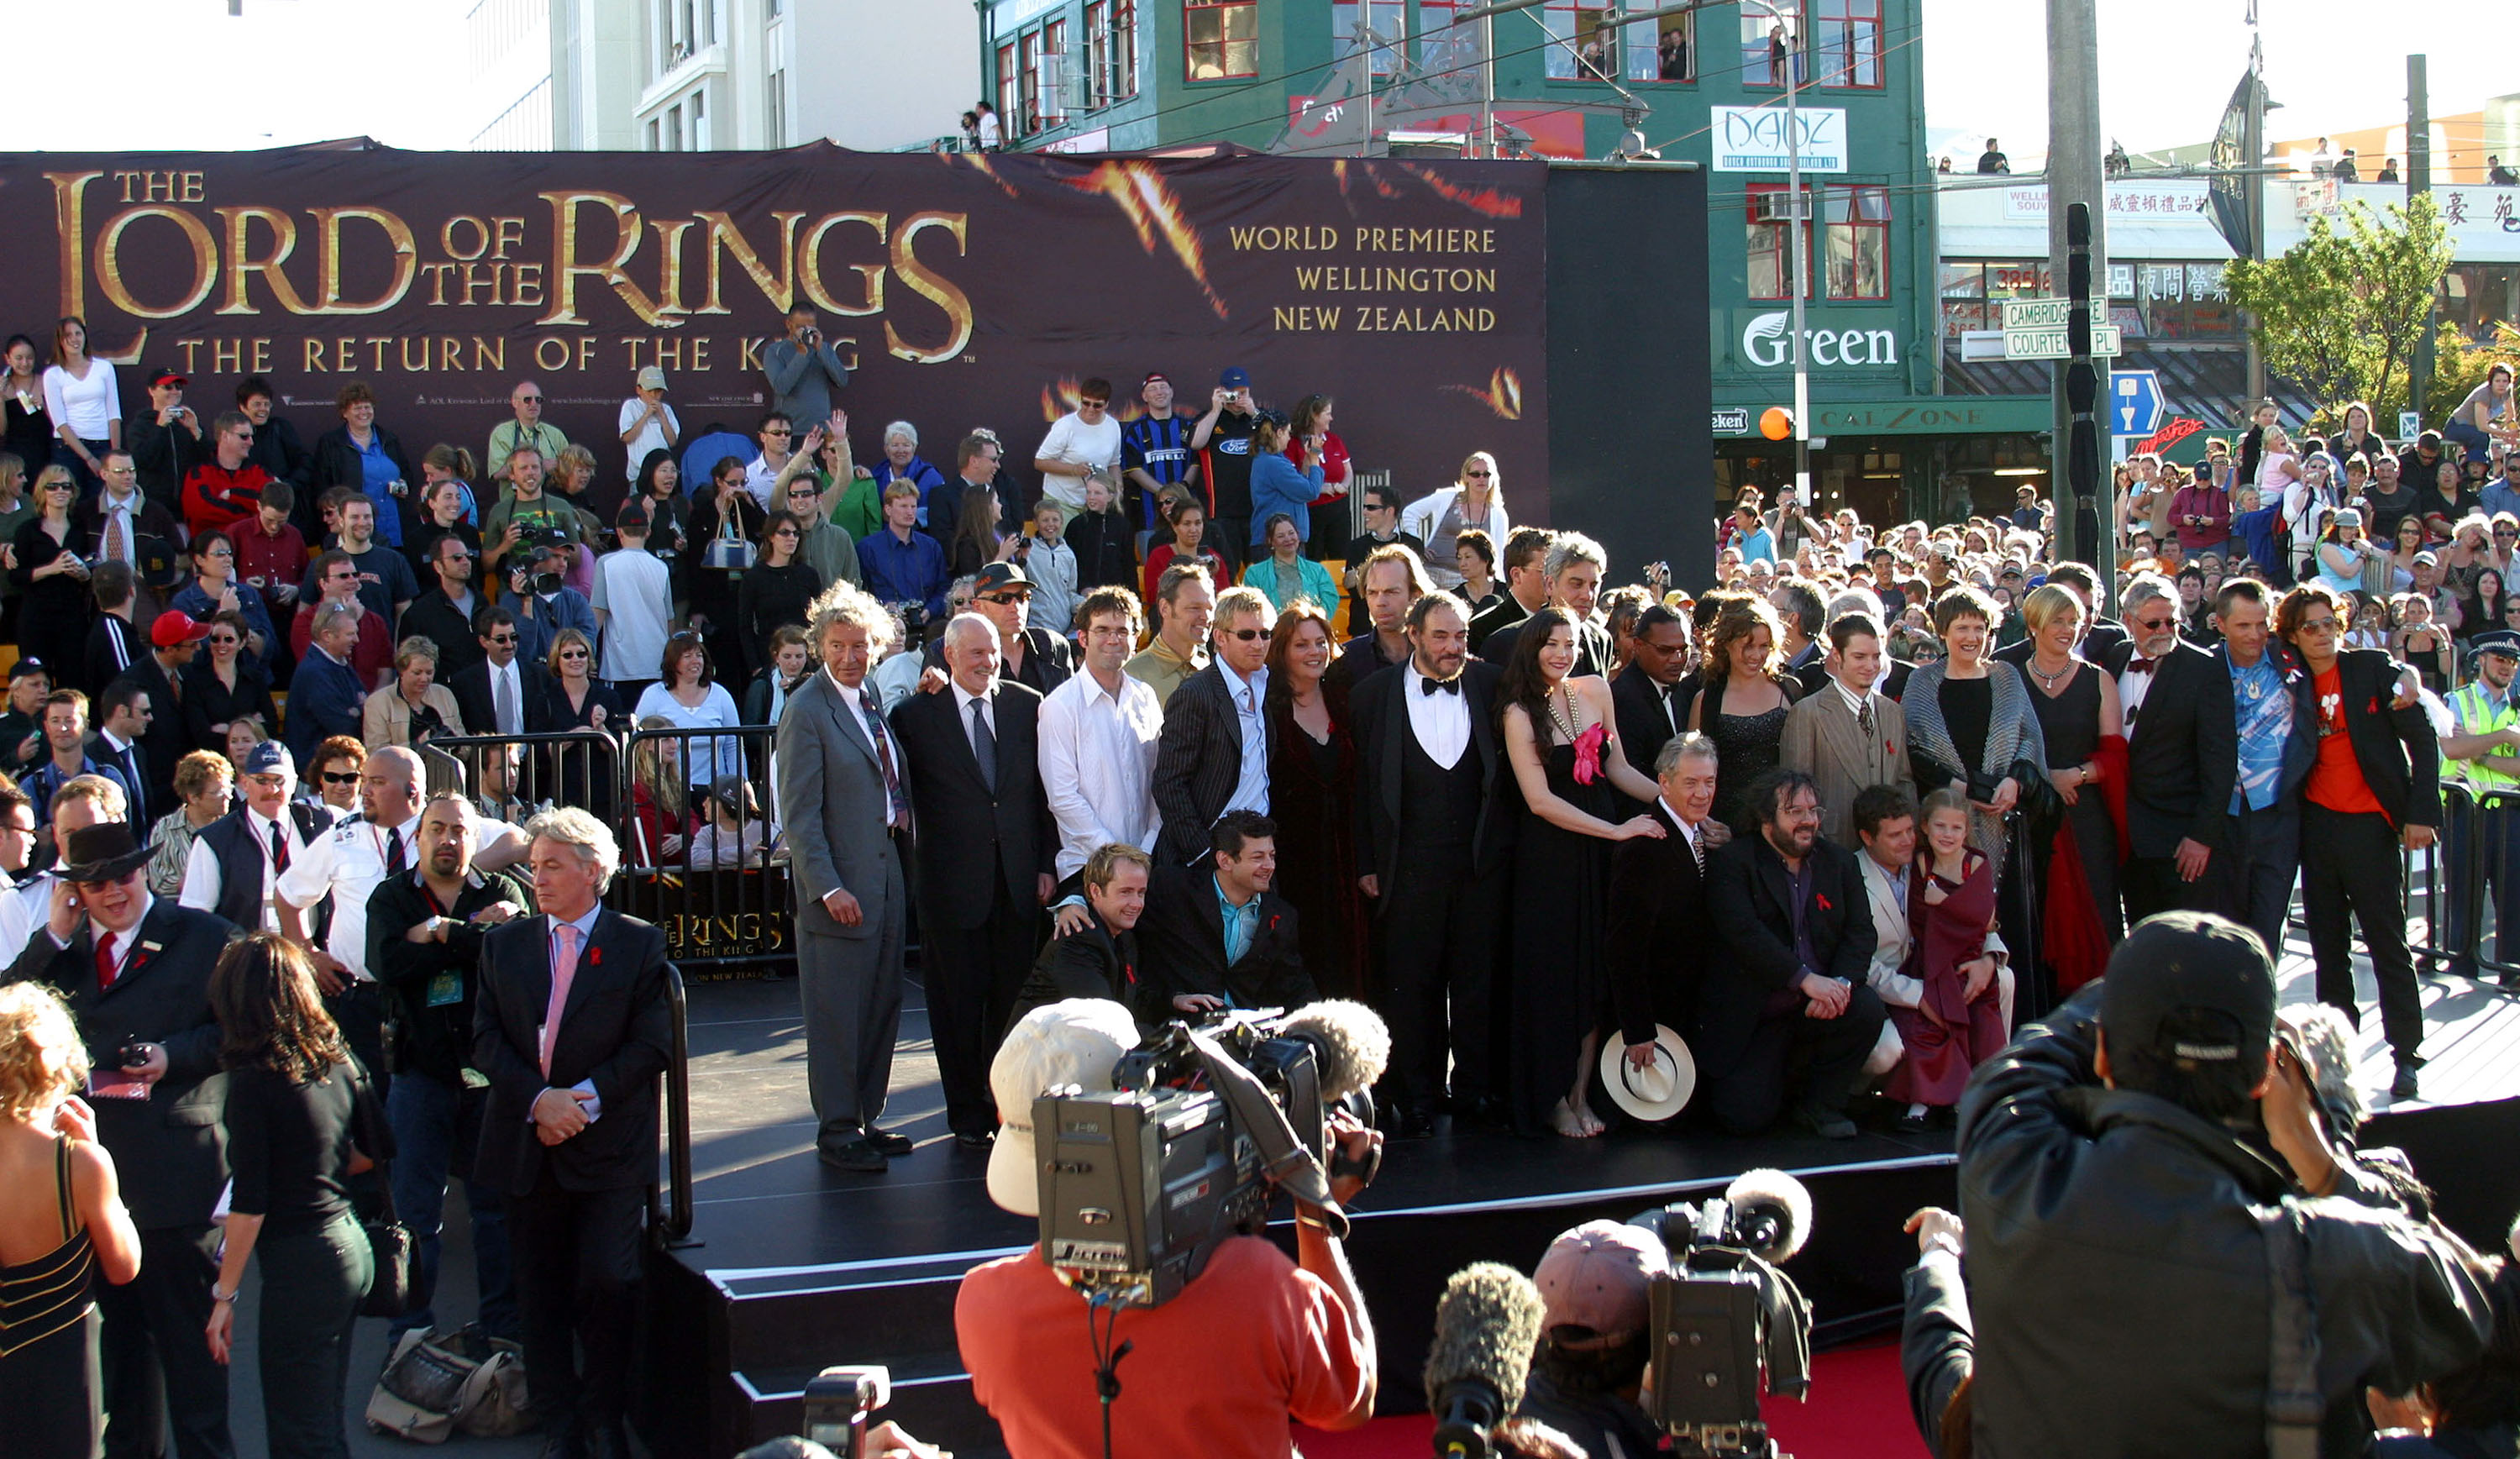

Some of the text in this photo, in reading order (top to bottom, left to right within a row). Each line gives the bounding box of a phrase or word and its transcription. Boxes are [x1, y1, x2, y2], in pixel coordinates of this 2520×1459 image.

[113, 171, 205, 202] THE
[2017, 201, 2048, 211] SOUV
[1230, 226, 1496, 254] WORLD PREMIERE
[43, 171, 974, 365] LORD OF THE RINGS
[1296, 266, 1496, 293] WELLINGTON
[1273, 307, 1496, 332] NEW ZEALAND
[1743, 311, 1898, 366] Green
[2013, 332, 2113, 354] COURTE PL
[177, 337, 858, 374] THE RETURN OF THE KG
[1711, 414, 1744, 428] eken
[1820, 407, 1984, 429] CALZONE
[1144, 448, 1186, 464] PIRELL
